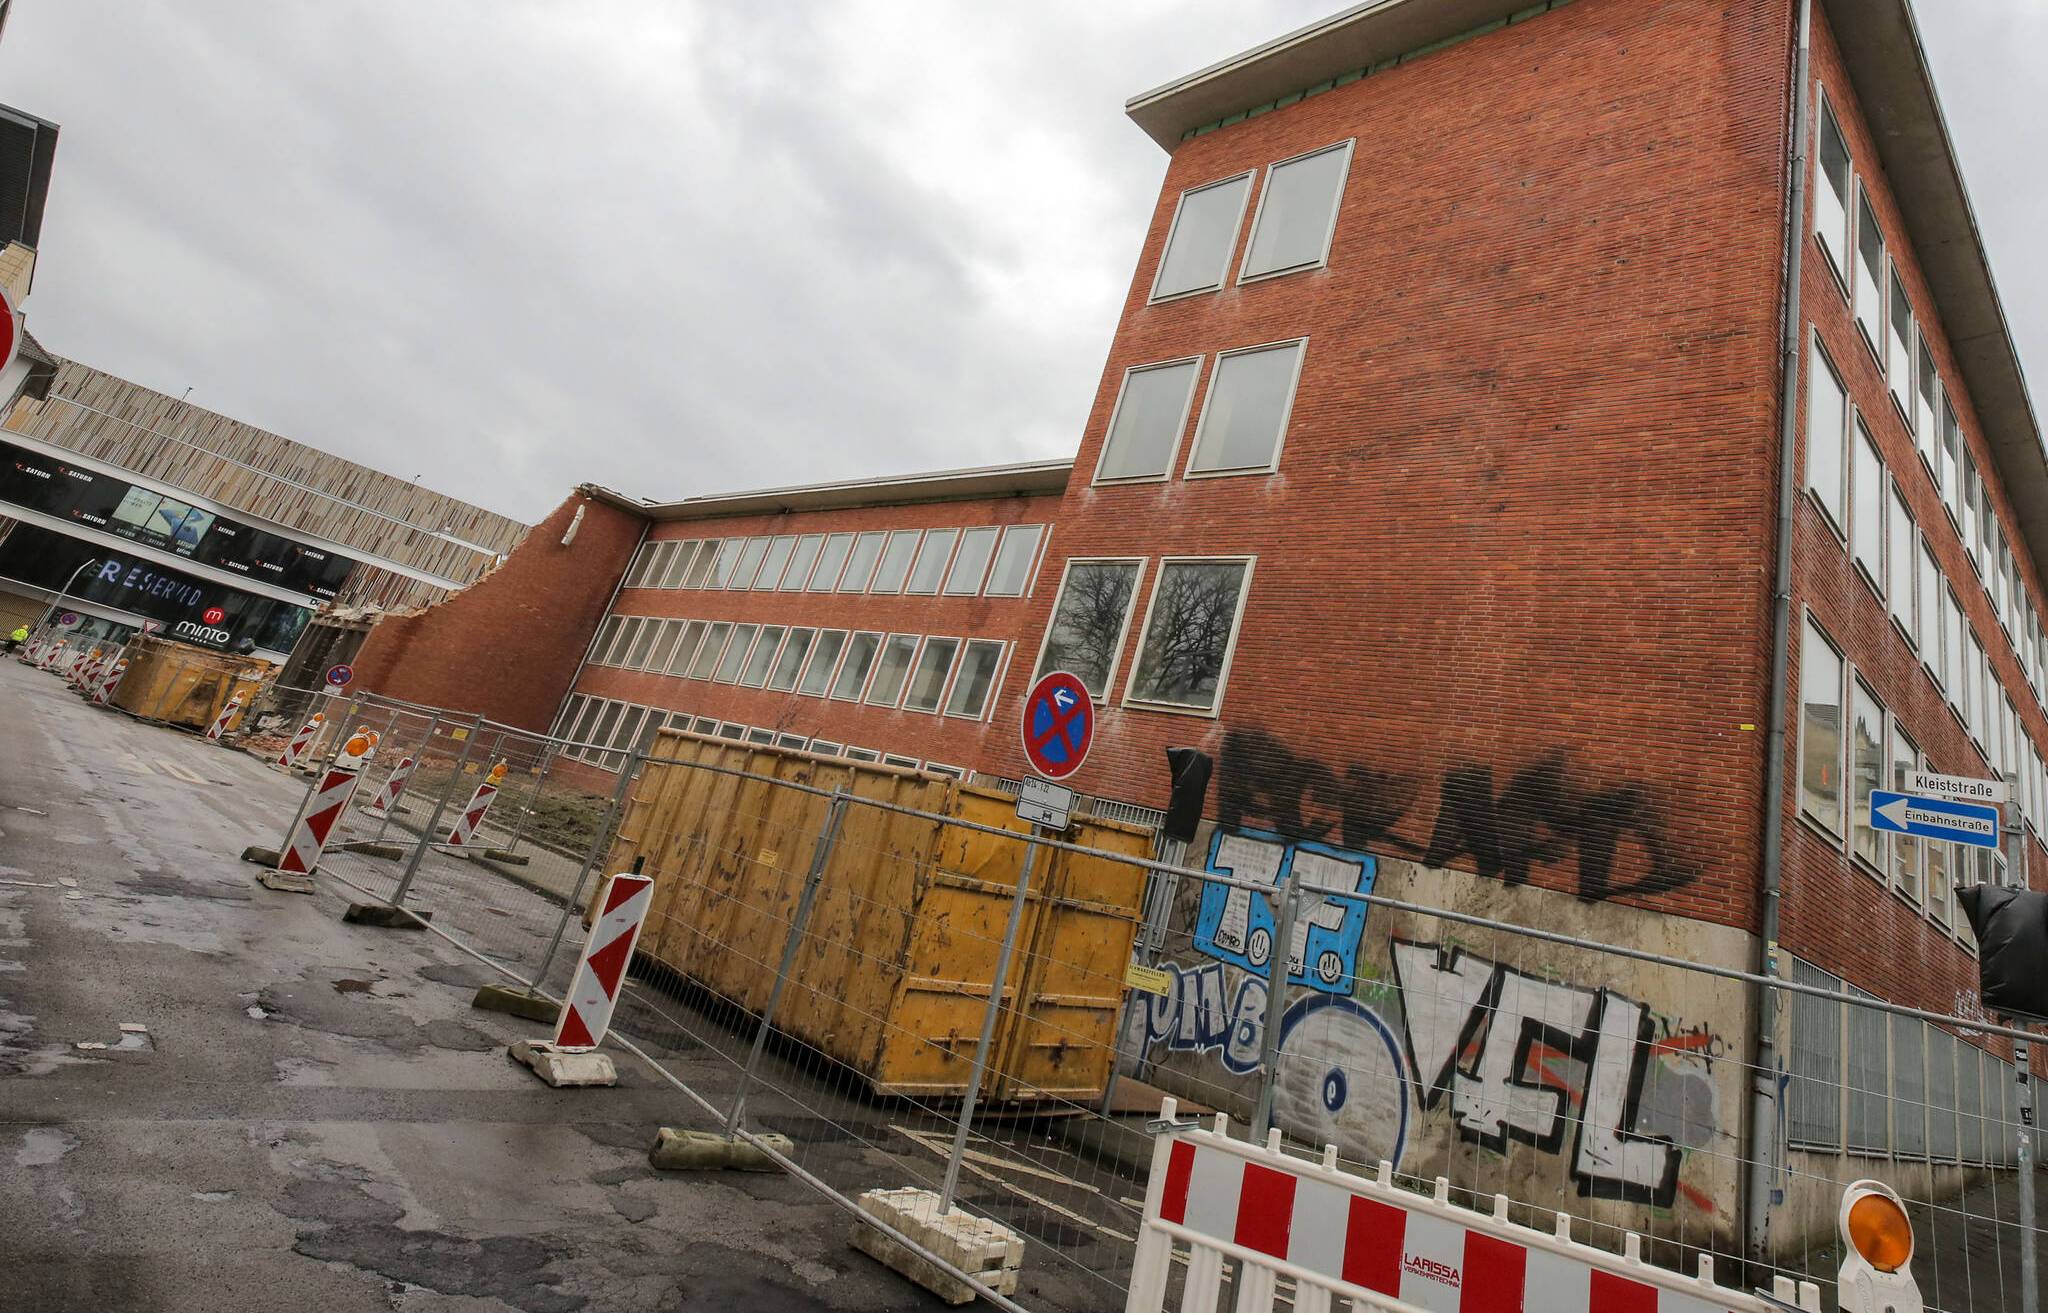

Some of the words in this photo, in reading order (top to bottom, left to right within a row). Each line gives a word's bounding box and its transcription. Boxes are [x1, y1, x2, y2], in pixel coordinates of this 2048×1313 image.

[25, 467, 51, 479] SATURN
[68, 470, 93, 482] SATURN
[82, 513, 107, 525] SATURN
[217, 526, 236, 537] SATURN
[304, 550, 325, 560] SATURN
[228, 561, 249, 572] SATURN
[262, 562, 284, 572] SATURN
[316, 587, 336, 597] SATURN
[1915, 775, 1993, 797] Kleiststraße
[1905, 810, 1990, 832] Einbahnstraße
[1404, 1252, 1460, 1282] LARISSA
[1403, 1265, 1461, 1288] VERKEHRSTECHNIK
